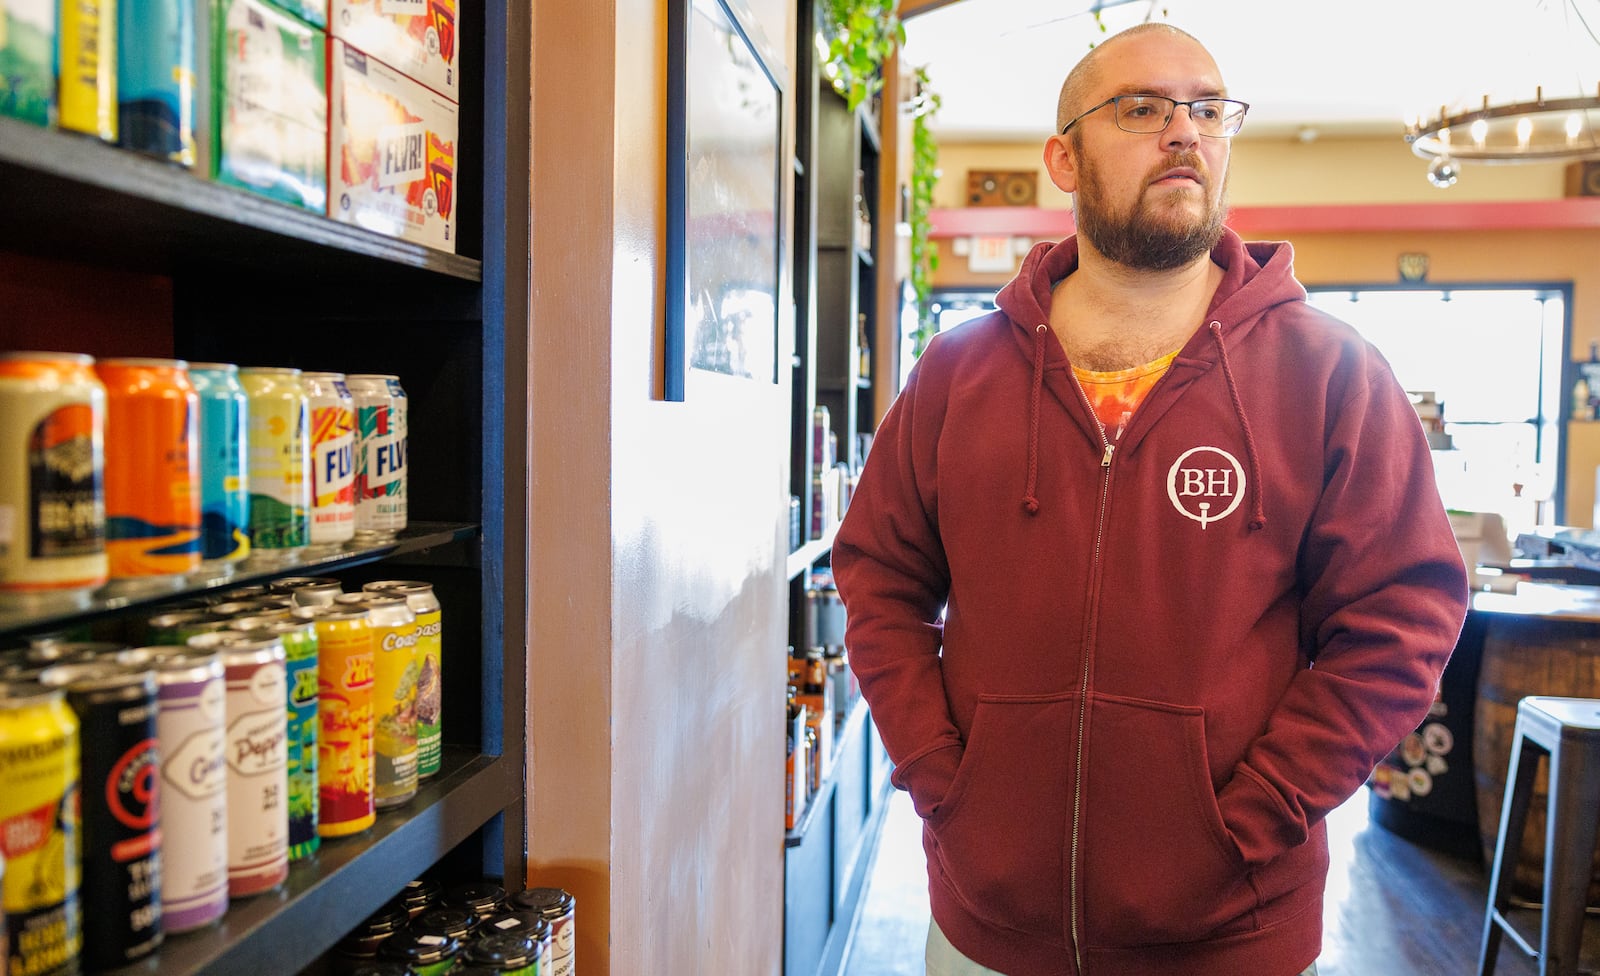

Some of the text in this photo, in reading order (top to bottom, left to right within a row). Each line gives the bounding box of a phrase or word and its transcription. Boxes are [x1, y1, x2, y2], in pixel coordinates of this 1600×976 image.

[384, 133, 423, 175] FLVR!
[376, 437, 407, 477] FLV
[1179, 468, 1233, 497] BH
